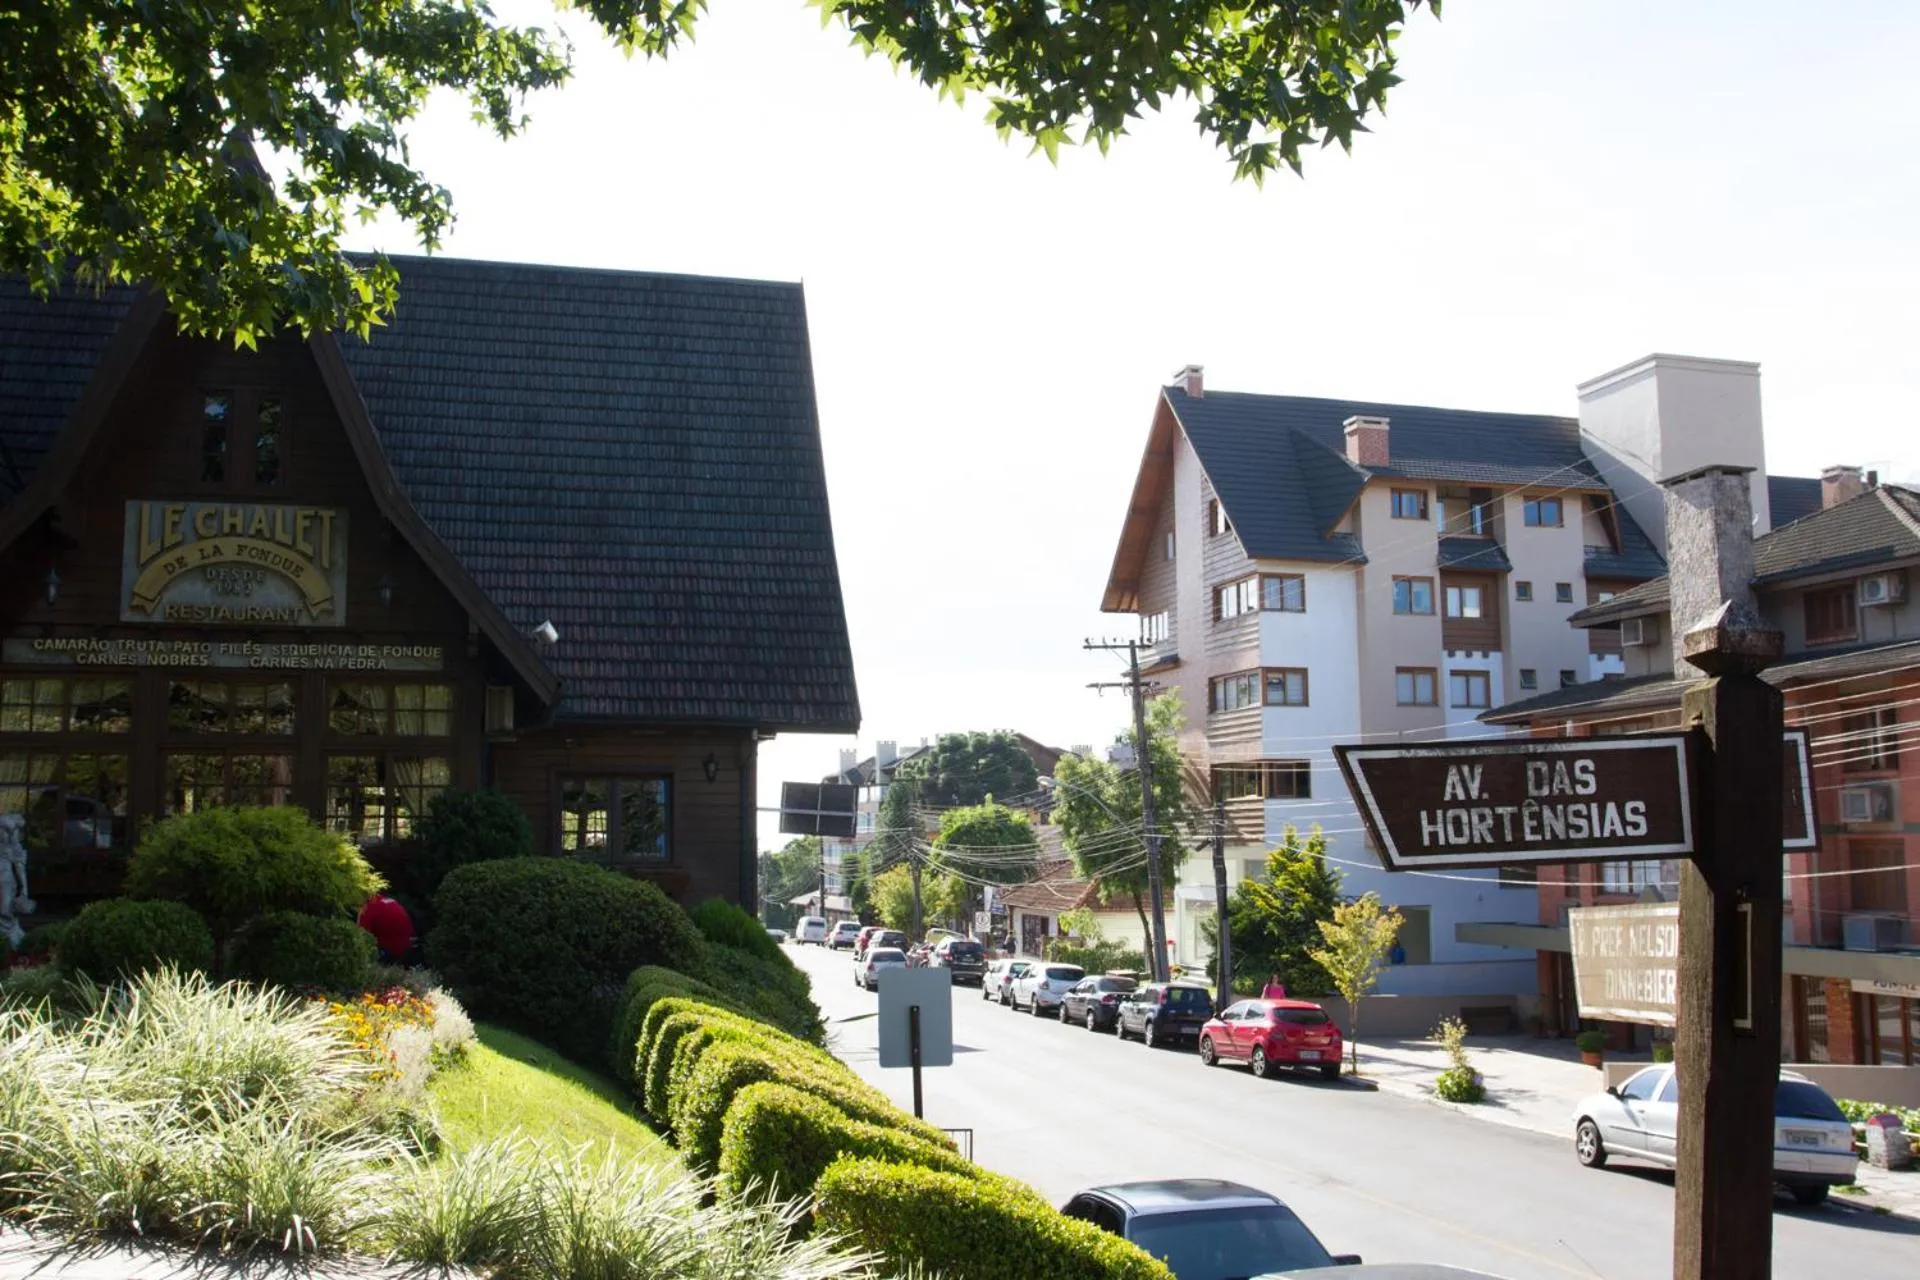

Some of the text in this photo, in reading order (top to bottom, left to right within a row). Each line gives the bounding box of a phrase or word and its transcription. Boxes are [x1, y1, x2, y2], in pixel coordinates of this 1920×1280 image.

[139, 502, 337, 571] LE CHALET
[163, 543, 305, 579] DE LA FONDUE
[206, 567, 266, 582] DESDE
[165, 603, 305, 622] RESTAURANT
[33, 637, 110, 652] CAMARÃO
[116, 639, 166, 652] TRUTA
[174, 640, 212, 654] PATO
[219, 640, 262, 656] FILÉS
[358, 645, 377, 657] DE
[382, 645, 442, 659] FONDUE
[76, 653, 209, 667] CARNES NOBRES
[250, 656, 387, 670] CARNES NA PEDRA
[1443, 758, 1597, 801] AV. DAS
[1420, 799, 1649, 847] HORTÊNSIAS
